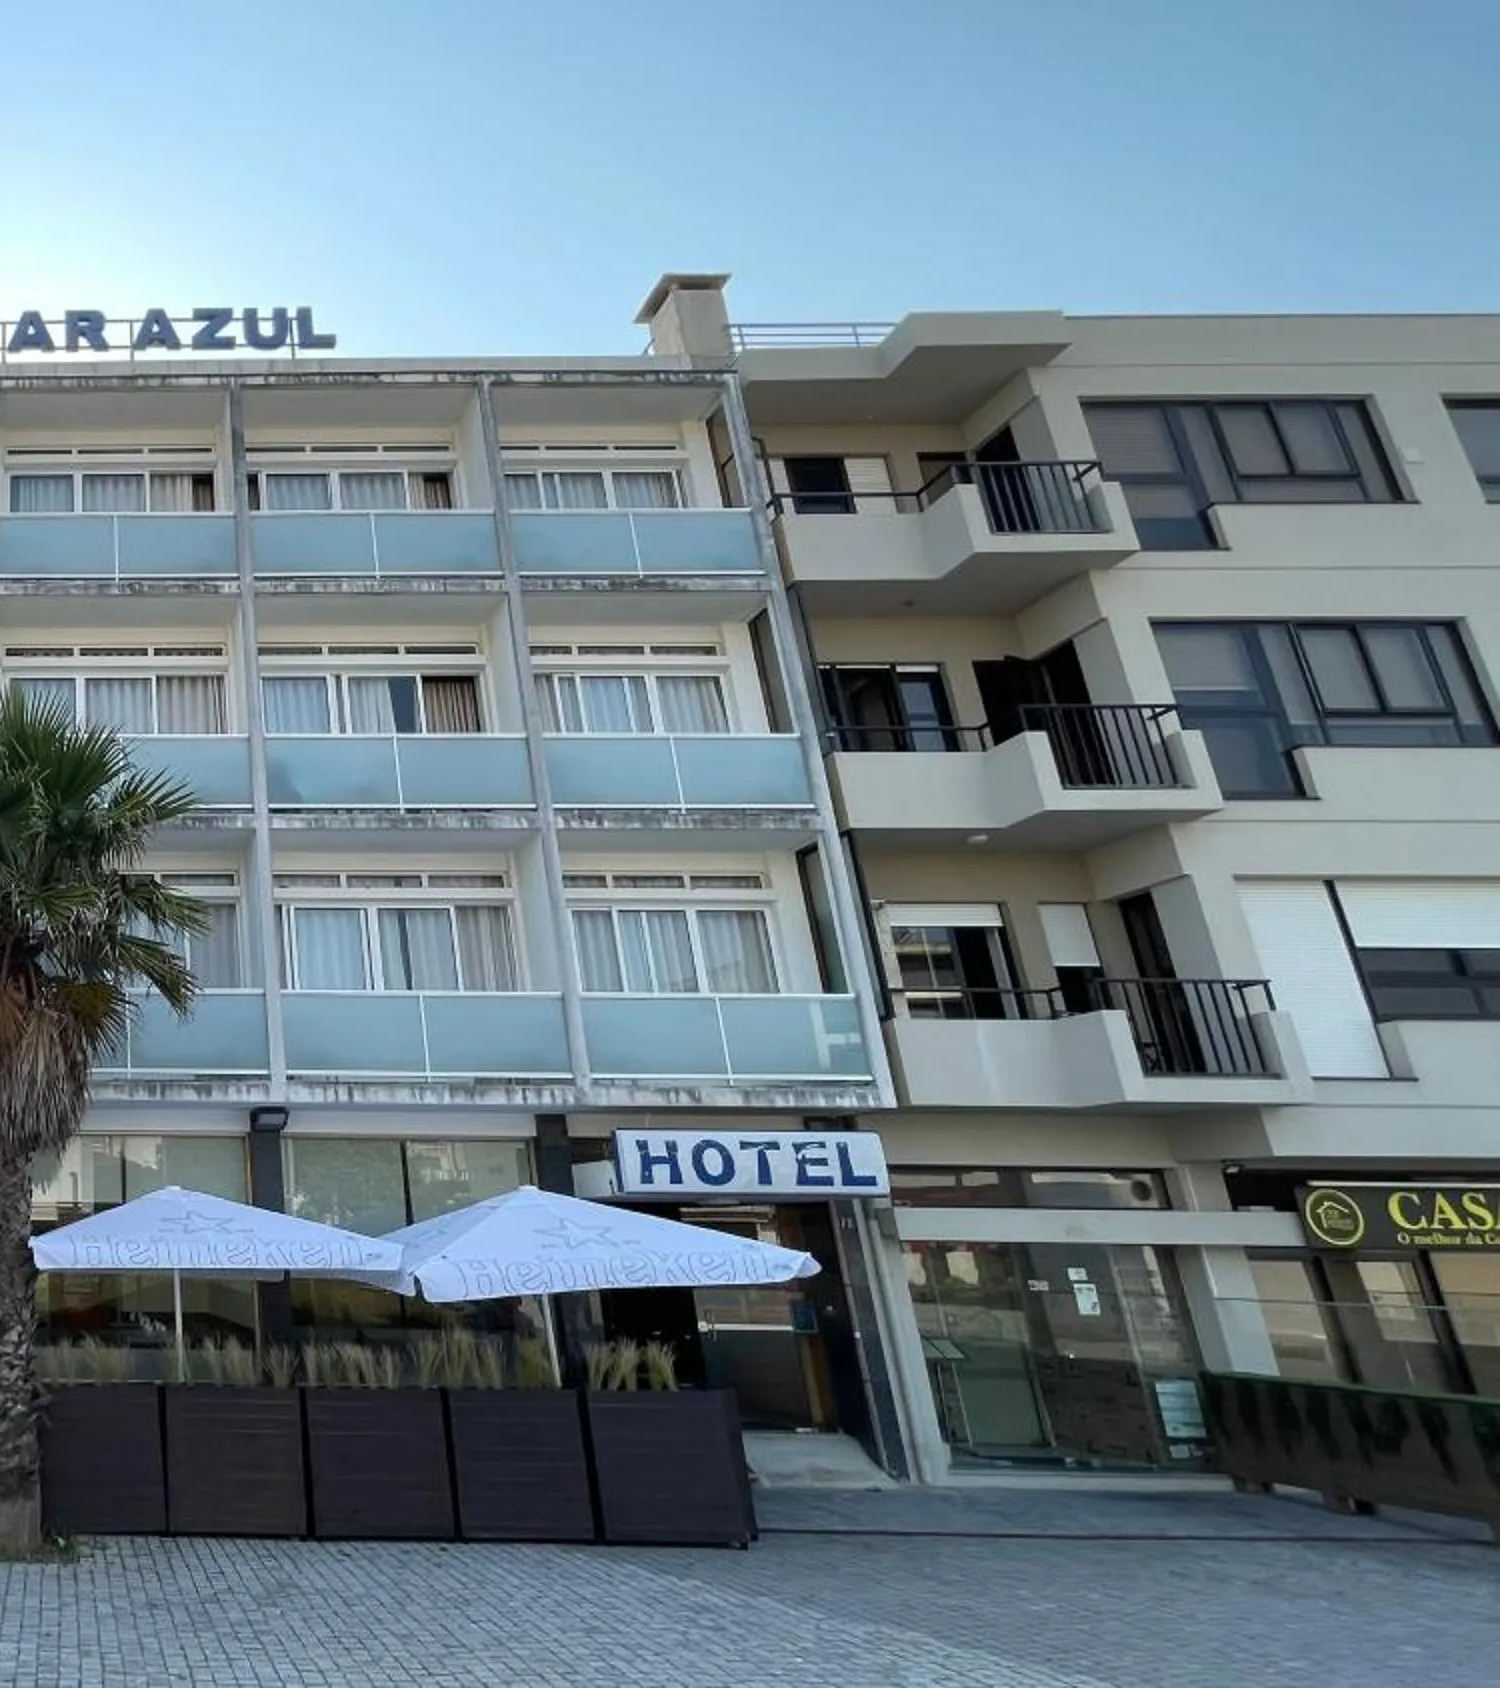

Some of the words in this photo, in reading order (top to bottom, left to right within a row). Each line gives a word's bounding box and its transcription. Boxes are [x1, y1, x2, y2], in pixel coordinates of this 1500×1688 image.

[133, 306, 337, 351] AZUL
[635, 1139, 878, 1187] HOTEL
[1387, 1191, 1500, 1230] CAS
[455, 1245, 772, 1297] Heineken
